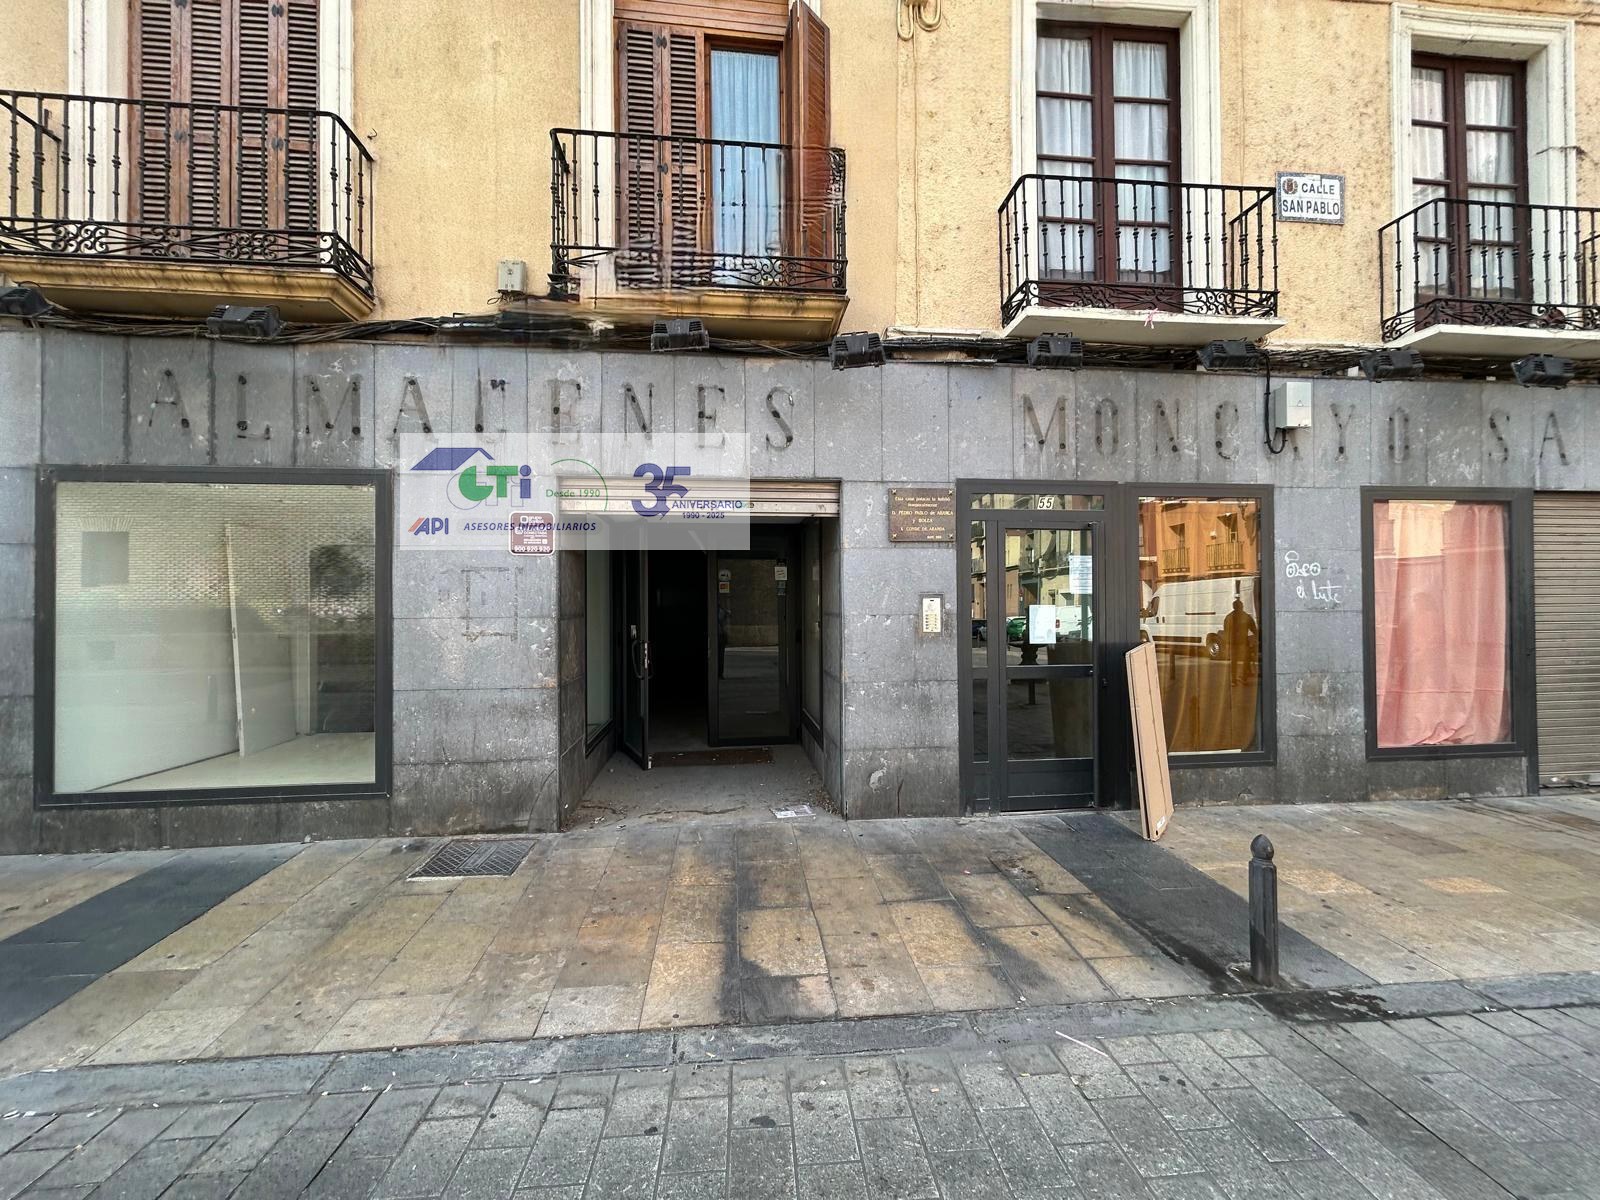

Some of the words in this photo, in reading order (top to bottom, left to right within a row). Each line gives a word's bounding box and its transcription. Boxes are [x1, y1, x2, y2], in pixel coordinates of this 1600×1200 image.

[1301, 183, 1335, 195] CALLE
[1282, 199, 1303, 213] SAN
[1306, 200, 1340, 215] PABLO
[1020, 393, 1411, 464] MONCYO
[1038, 497, 1053, 509] 55
